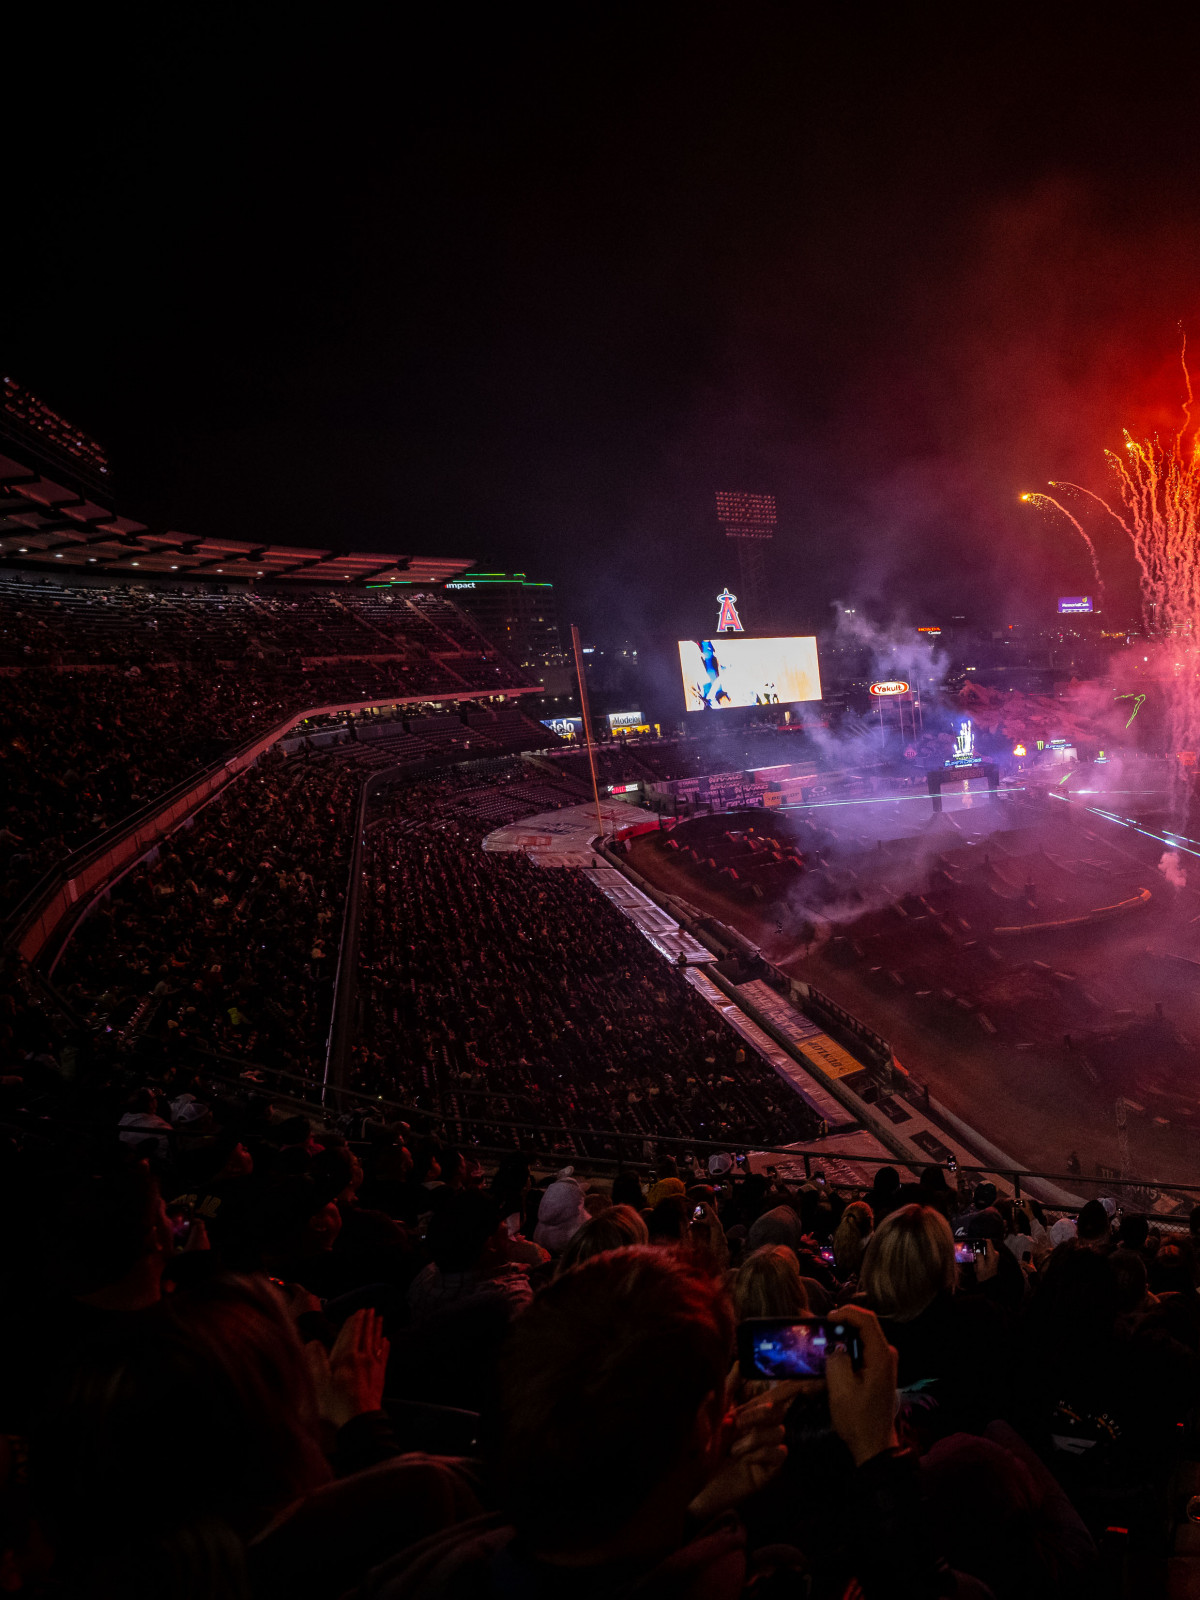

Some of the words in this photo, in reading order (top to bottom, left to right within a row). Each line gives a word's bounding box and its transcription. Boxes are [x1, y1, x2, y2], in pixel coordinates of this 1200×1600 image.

[877, 684, 902, 693] Yakult
[549, 719, 575, 734] delo
[613, 715, 640, 726] Modelo
[808, 1041, 841, 1068] DUNLOP
